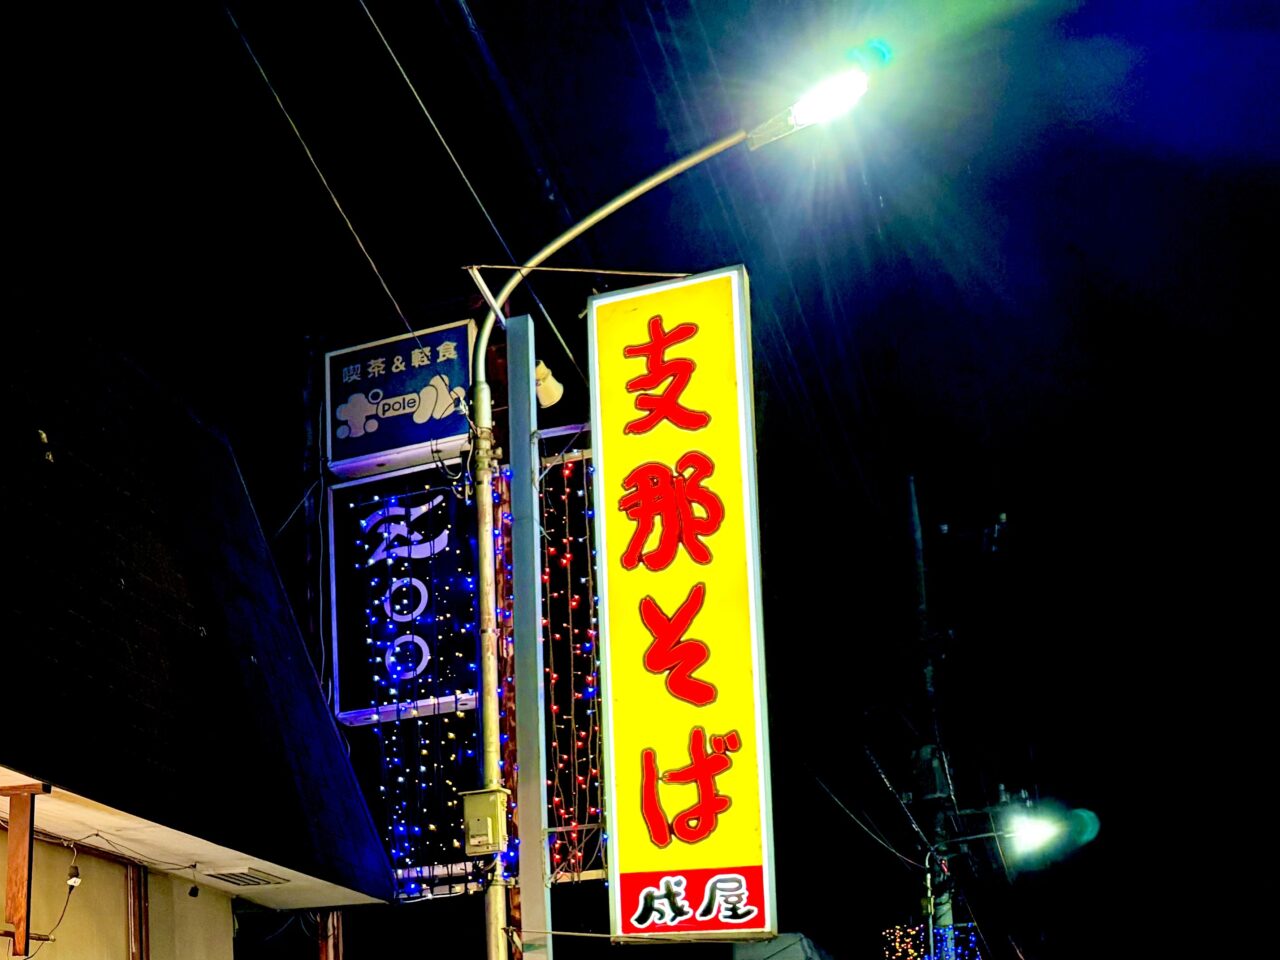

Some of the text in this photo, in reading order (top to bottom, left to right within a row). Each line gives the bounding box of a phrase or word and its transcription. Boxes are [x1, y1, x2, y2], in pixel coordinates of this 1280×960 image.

[382, 398, 417, 416] pole
[621, 315, 741, 849] 支那そば
[631, 874, 757, 928] 成屋
